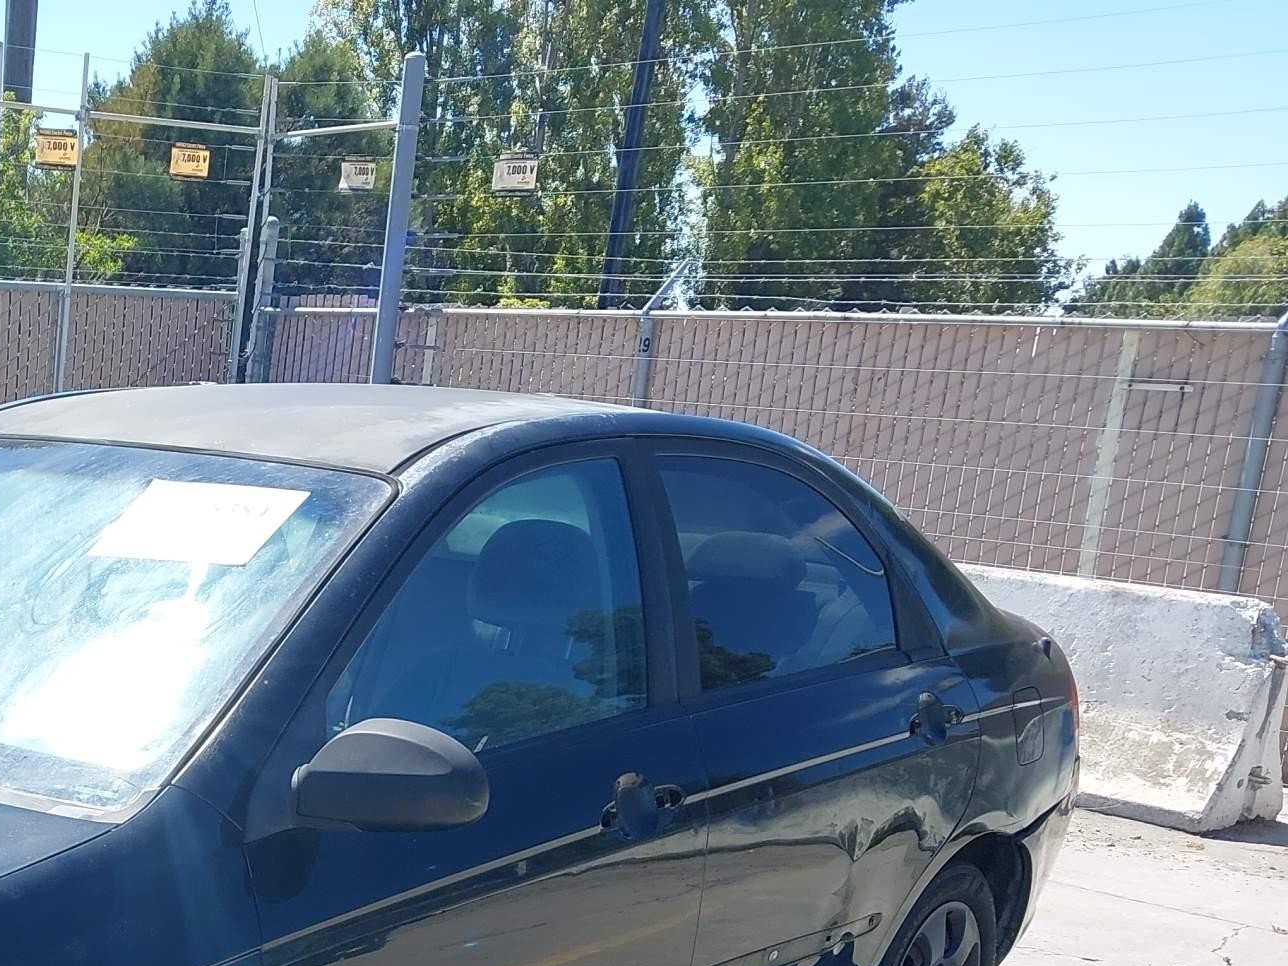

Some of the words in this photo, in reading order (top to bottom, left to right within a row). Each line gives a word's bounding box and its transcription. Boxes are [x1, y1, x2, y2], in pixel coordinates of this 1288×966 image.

[47, 140, 68, 152] 7,000
[182, 153, 201, 164] 7,000
[506, 164, 528, 176] 7,000
